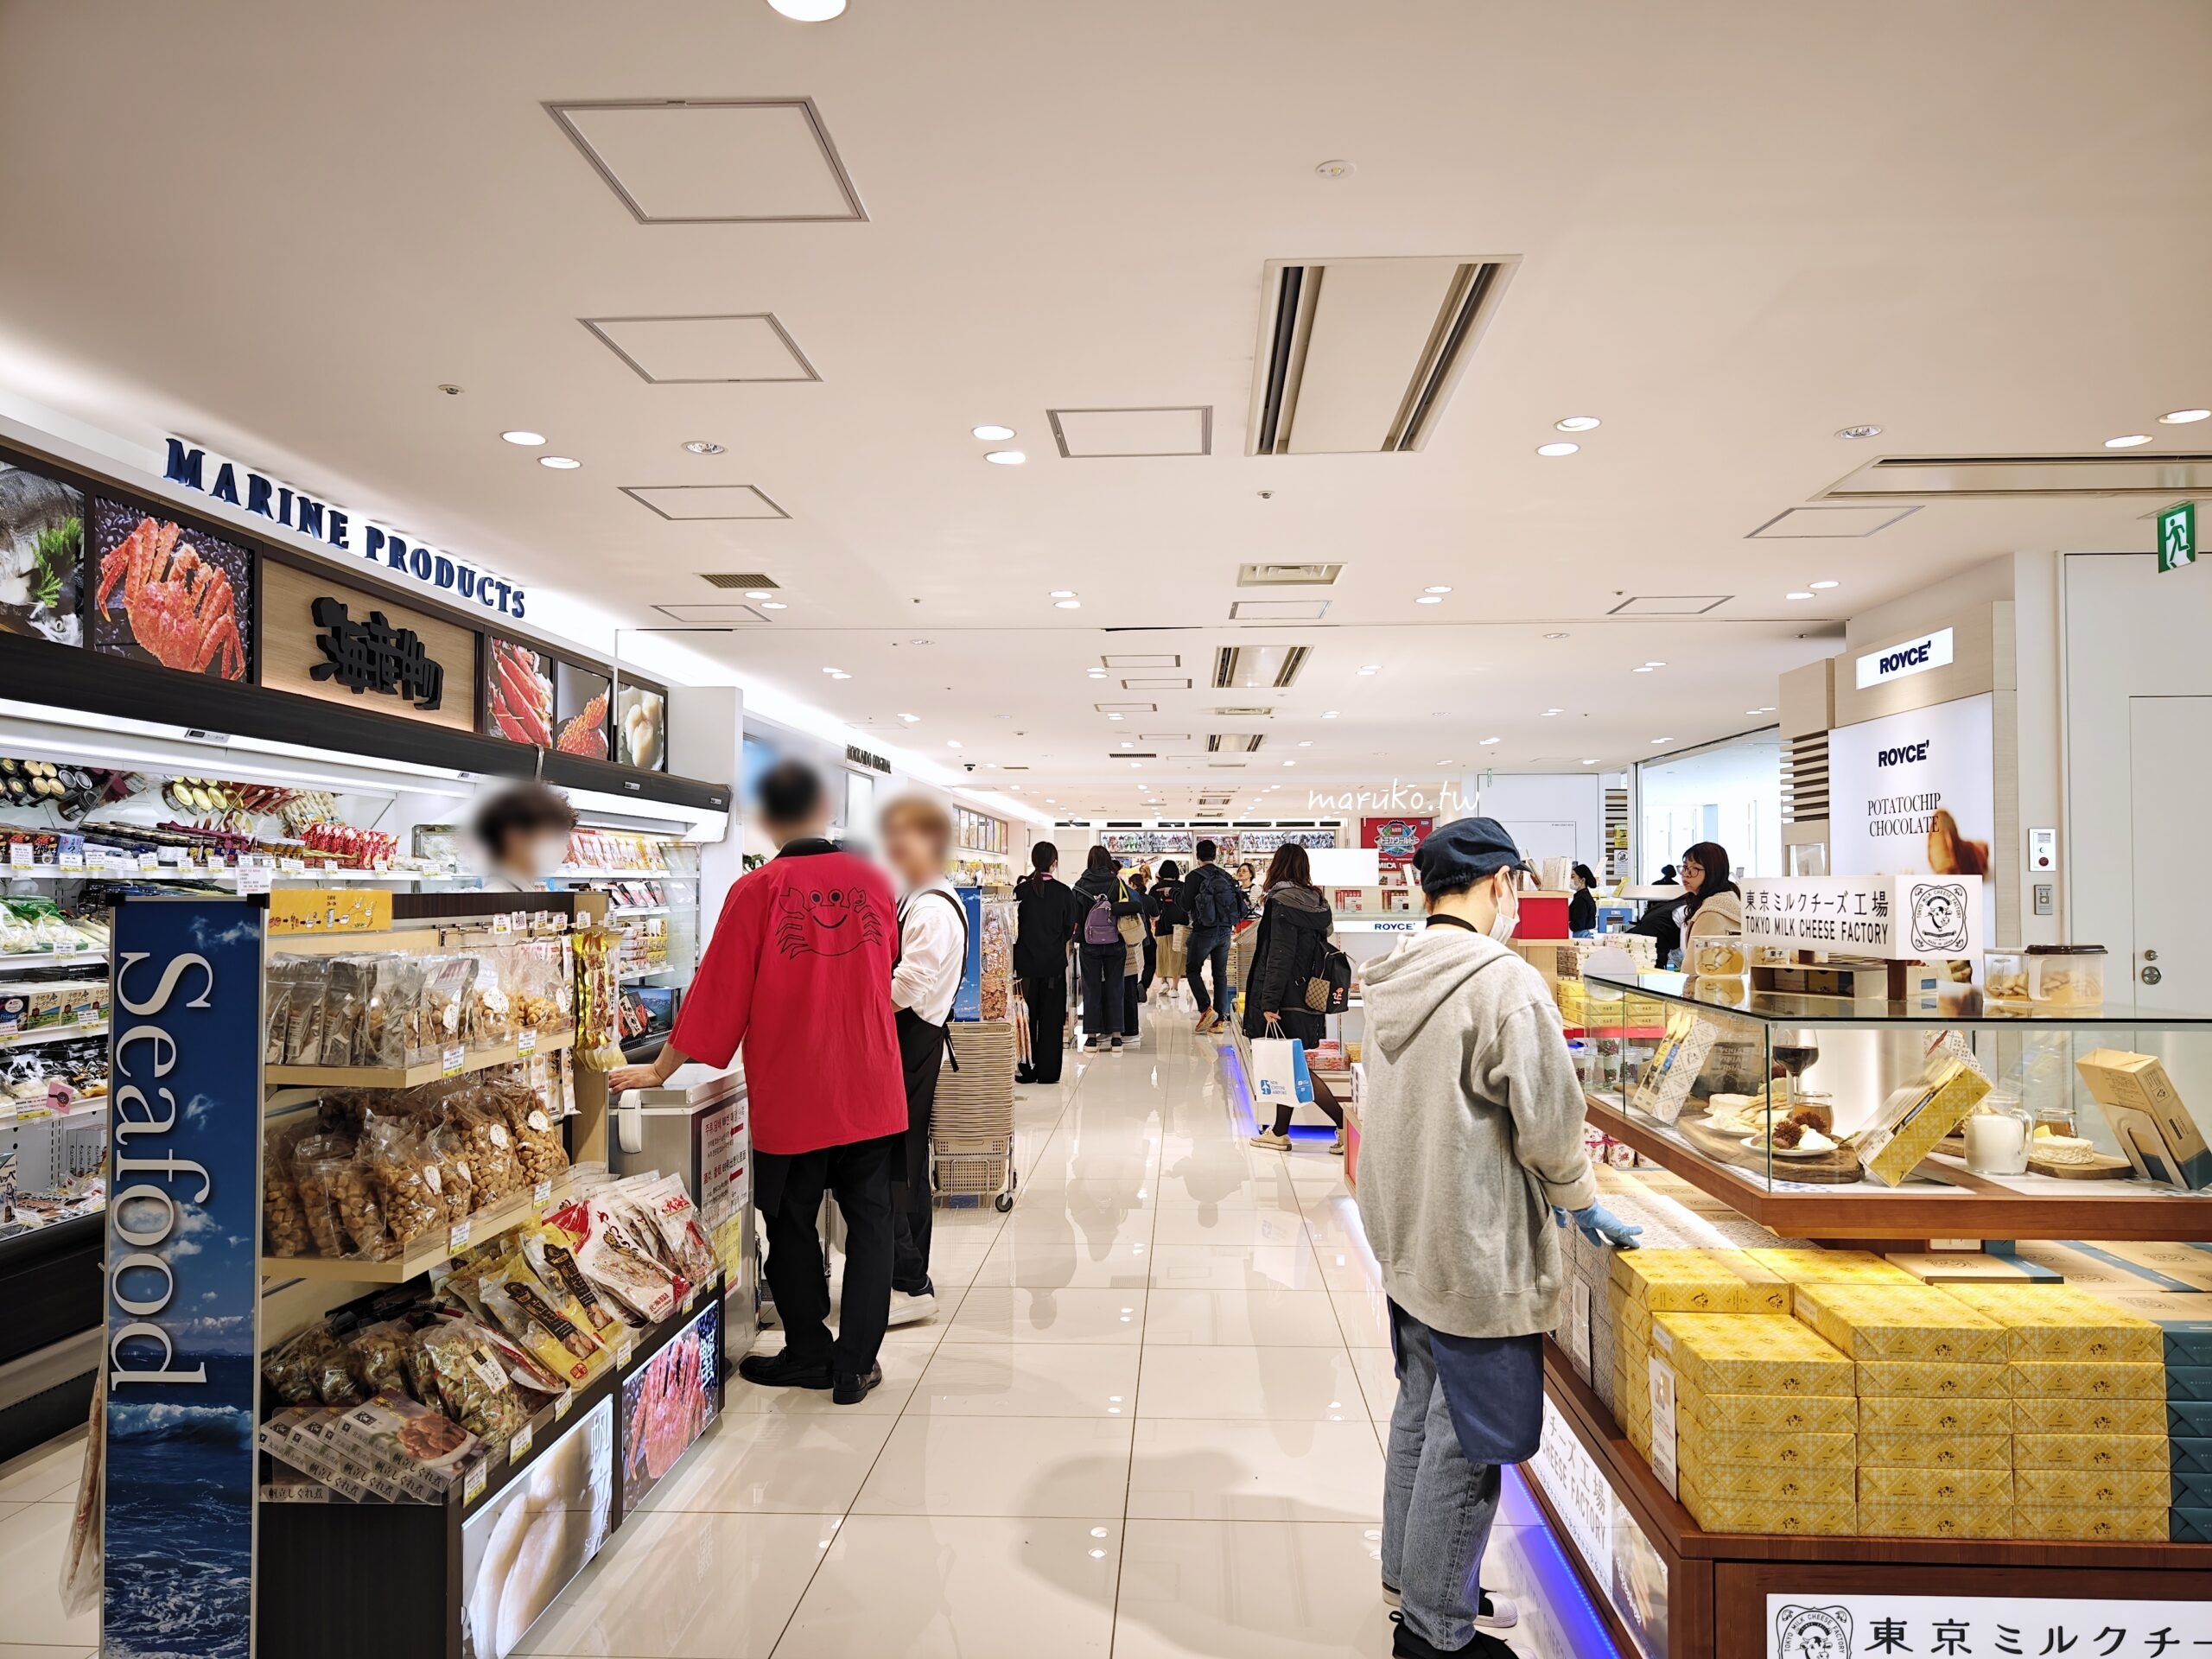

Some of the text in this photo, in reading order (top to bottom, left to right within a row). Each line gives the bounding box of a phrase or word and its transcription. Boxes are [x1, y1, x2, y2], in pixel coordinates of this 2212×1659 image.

[163, 438, 525, 619] MARINE PRODUCTS
[310, 597, 444, 710] 海産物
[1867, 792, 1942, 817] POTATOCHIP
[1869, 816, 1940, 836] CHOCOLATE
[1745, 890, 1889, 918] 東京ミルクチーズ工場
[1745, 916, 1888, 944] TOKYO MILK CHEESE FACTORY
[111, 951, 213, 1391] Seafood
[309, 1462, 359, 1497] 帆立しぐれ煮
[343, 1462, 394, 1496] 帆立しぐれ煮
[374, 1460, 424, 1496] 帆立しぐれ煮
[392, 1452, 444, 1488] 帆立しぐれ煮
[268, 1488, 323, 1499] 帆立しぐれ煮
[1541, 1431, 1605, 1550] CHEESE FACTORY
[1784, 1632, 1794, 1652] TOKYO
[1791, 1617, 1805, 1630] MILK
[1808, 1613, 1833, 1625] CHEESE
[1832, 1625, 1845, 1654] FACTORY
